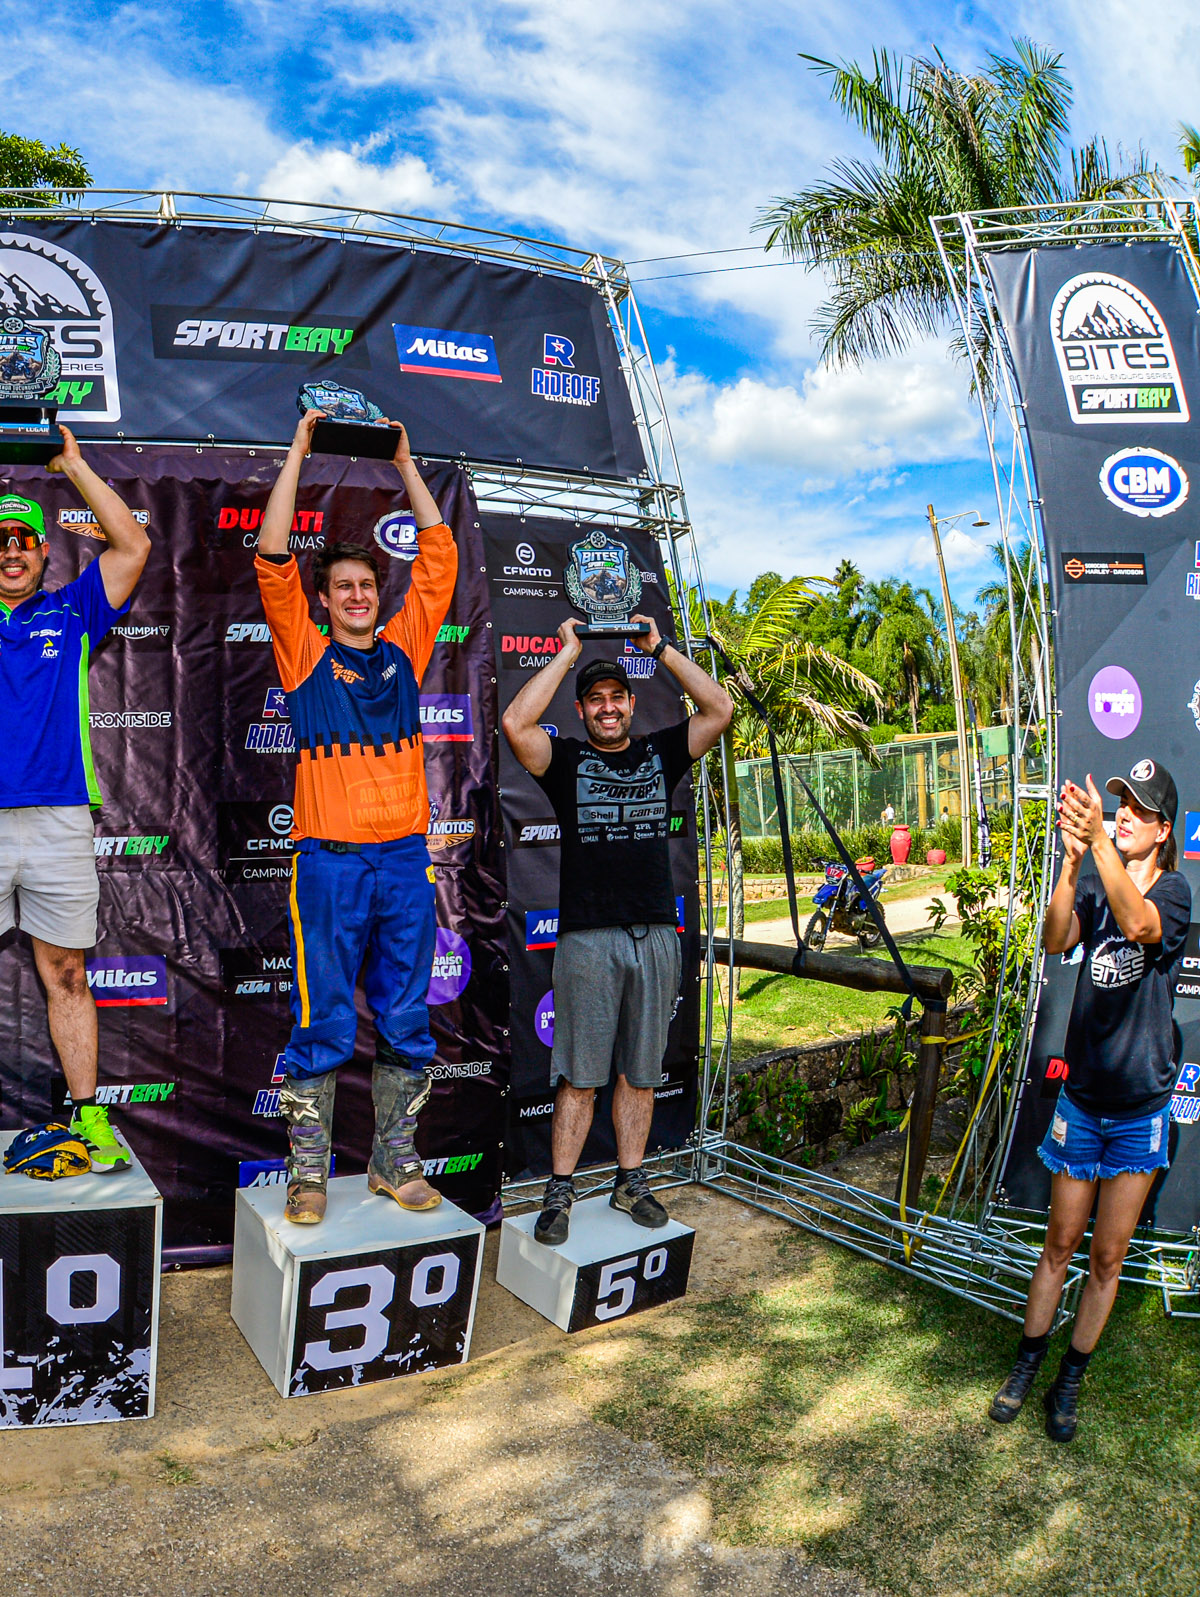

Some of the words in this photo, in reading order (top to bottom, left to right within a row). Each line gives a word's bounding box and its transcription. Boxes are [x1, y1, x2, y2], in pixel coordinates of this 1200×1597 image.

[173, 320, 354, 355] SPORTBAY
[406, 337, 489, 363] Mitas
[1062, 343, 1170, 371] BITES
[59, 364, 104, 373] ERIES
[1081, 387, 1172, 409] SPORTBAY
[1113, 467, 1171, 494] CBM
[385, 524, 420, 544] CB
[582, 551, 619, 563] BITES
[503, 566, 552, 578] CFMOTO
[503, 587, 544, 598] CAMPINAS
[548, 589, 558, 598] SP
[111, 626, 159, 640] TRIUMPH
[420, 706, 464, 723] itas
[590, 811, 614, 819] Shell
[433, 821, 475, 835] MOTOS
[247, 838, 294, 851] CFMO
[243, 867, 294, 880] CAMPINA
[1090, 954, 1146, 984] BITES
[235, 980, 271, 995] KTM
[520, 1103, 555, 1118] MAGGI
